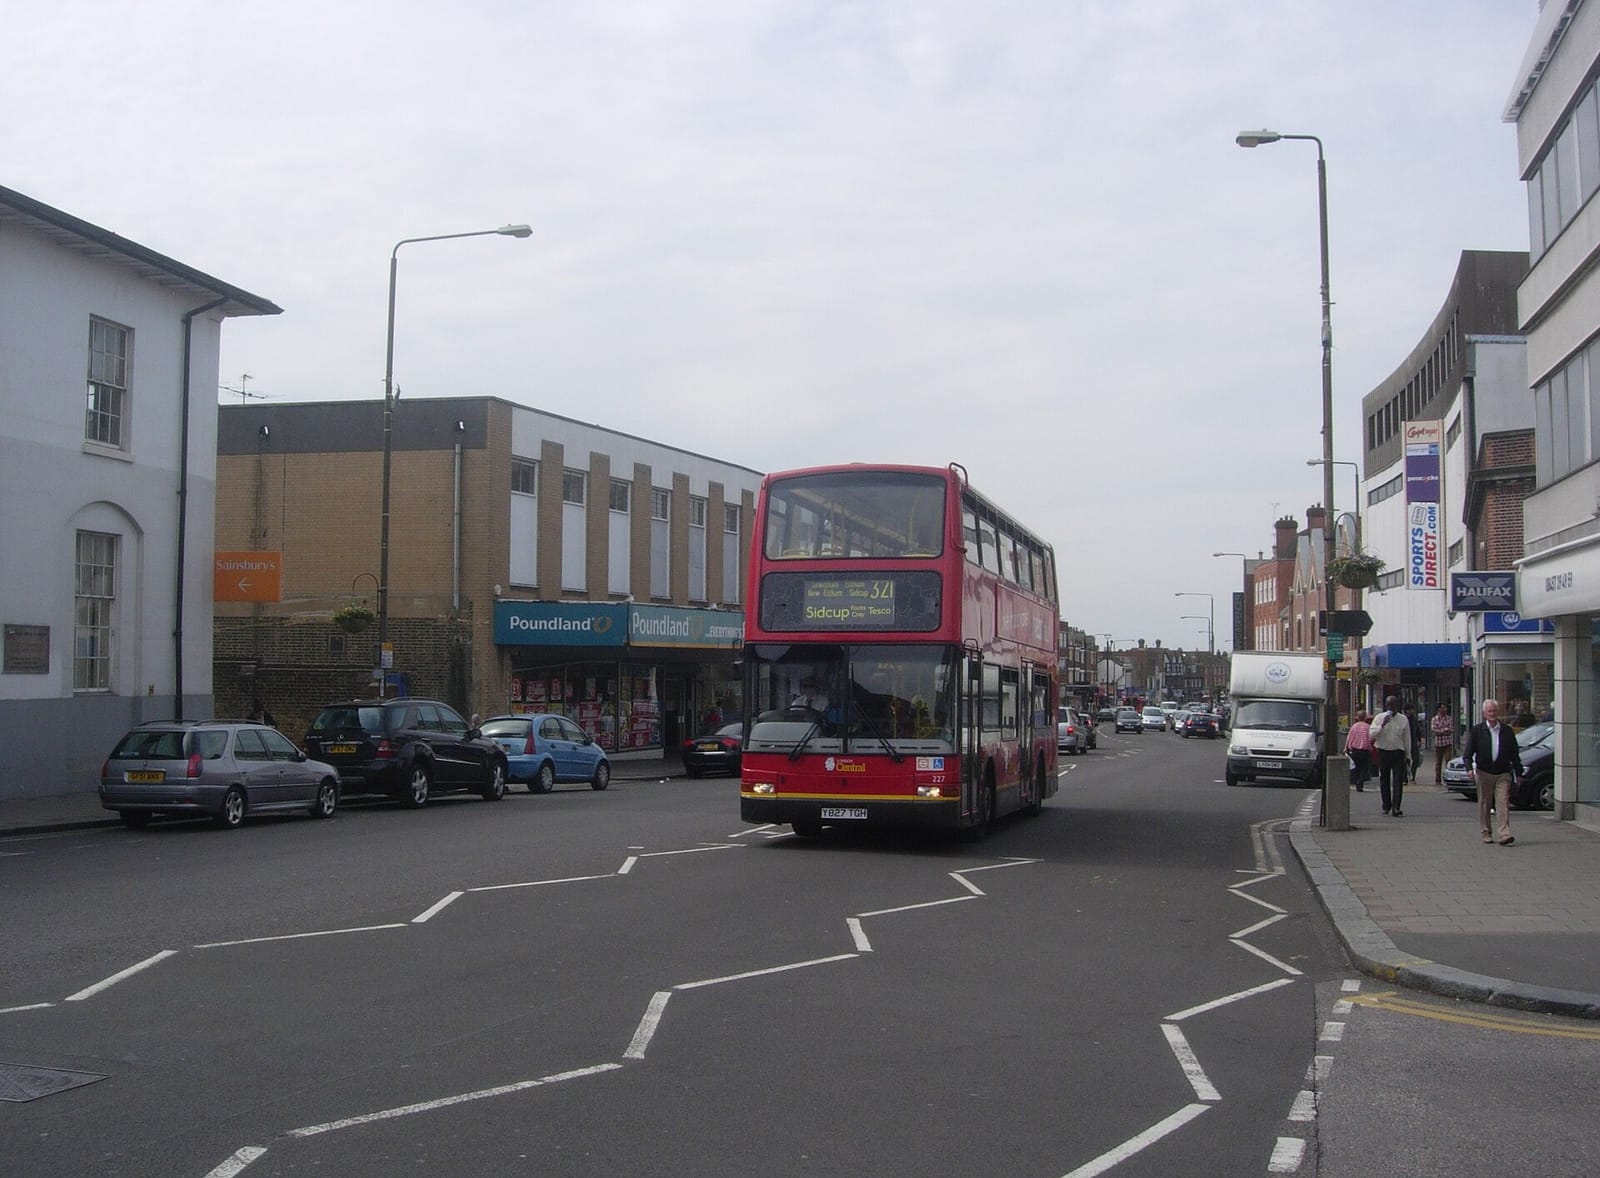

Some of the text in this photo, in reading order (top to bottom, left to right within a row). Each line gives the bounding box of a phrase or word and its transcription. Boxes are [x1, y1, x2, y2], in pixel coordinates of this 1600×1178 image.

[1411, 527, 1424, 586] SPORTS
[216, 559, 276, 572] Sainsbury's
[870, 580, 894, 599] 321
[1456, 586, 1512, 597] HALIFAX
[806, 605, 892, 621] Sidcup Tesco
[509, 615, 591, 631] Poundland
[632, 612, 689, 637] Poundland
[836, 763, 866, 773] Central
[932, 775, 945, 783] 227
[822, 809, 867, 819] Y827 TGH
